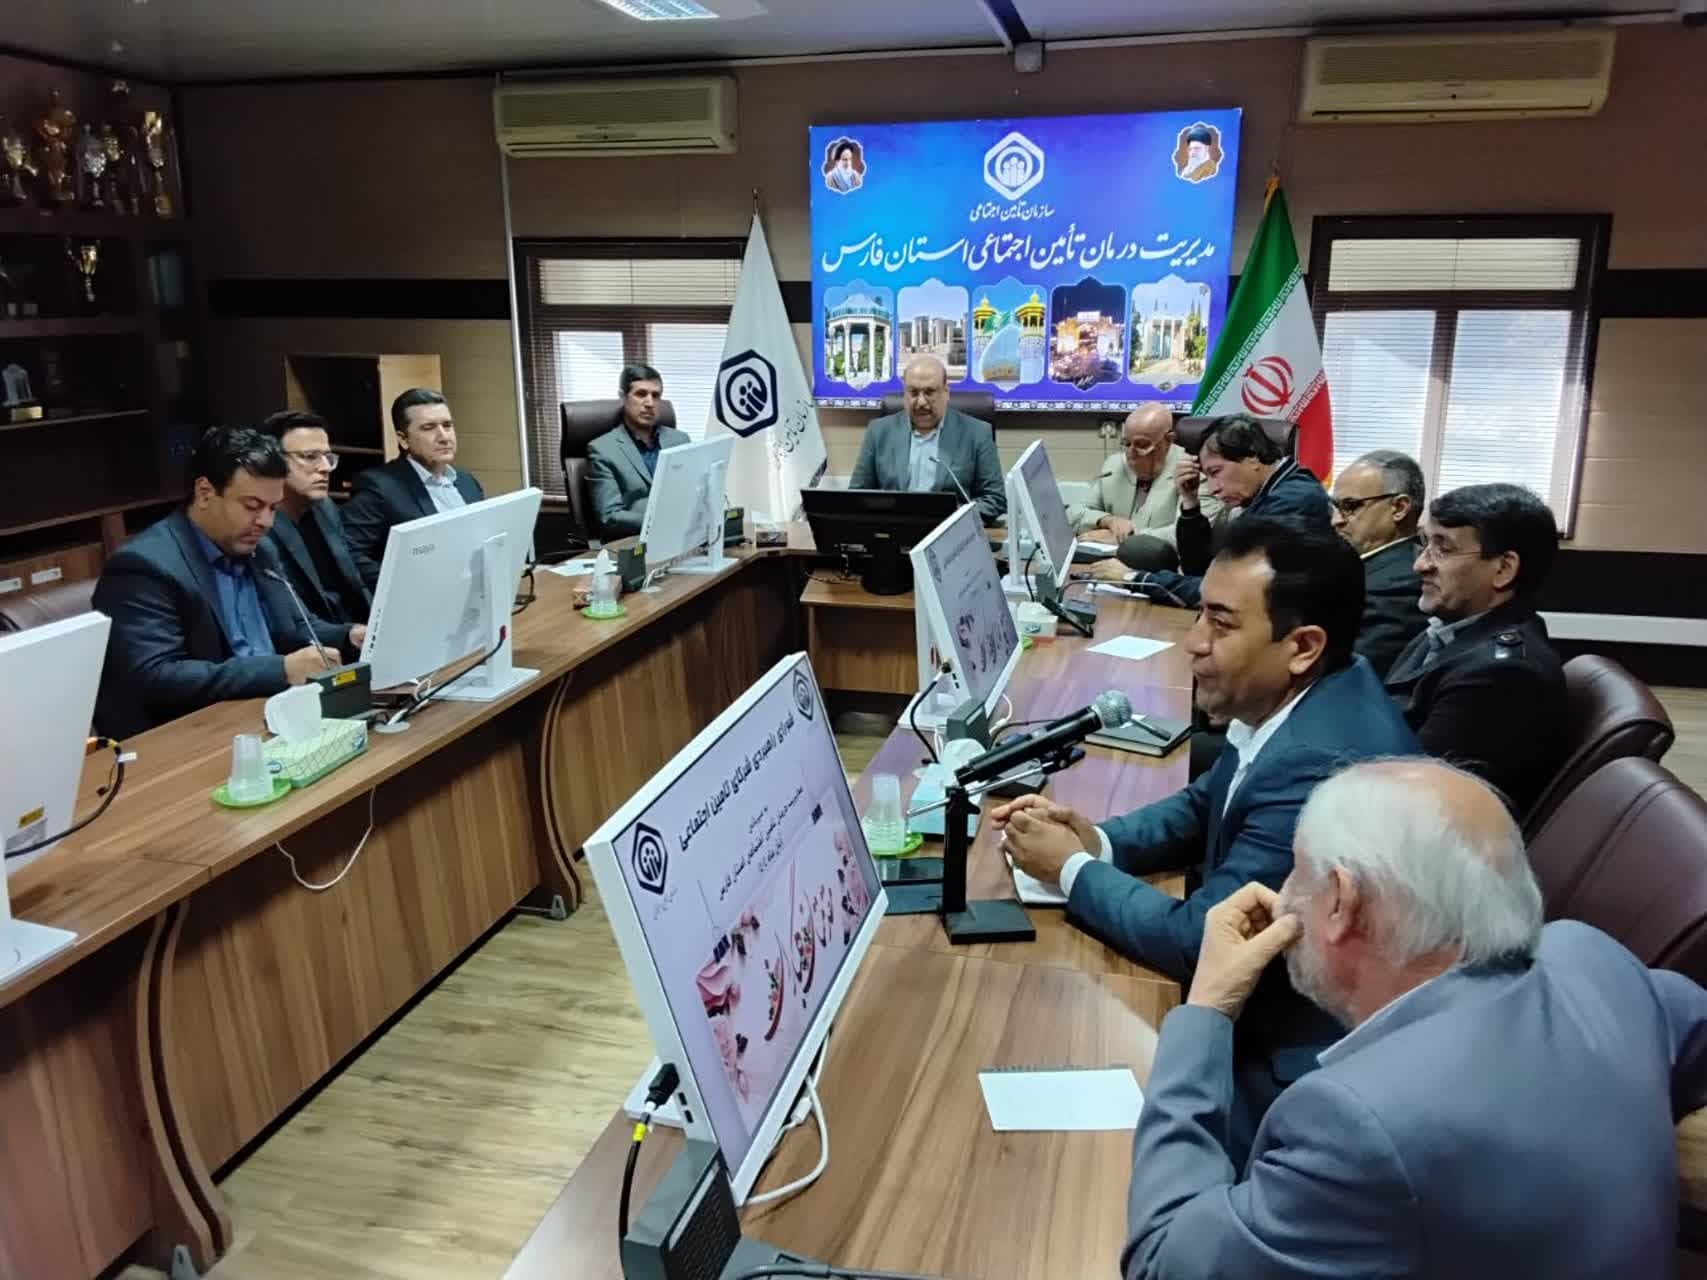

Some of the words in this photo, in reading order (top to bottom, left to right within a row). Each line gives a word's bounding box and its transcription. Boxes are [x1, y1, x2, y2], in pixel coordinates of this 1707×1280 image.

[969, 201, 1000, 222] اجتماعی
[1021, 203, 1056, 221] سازمان
[821, 231, 884, 273] فارس
[883, 236, 969, 272] استان
[967, 232, 1032, 271] اجتماعی
[1029, 223, 1086, 270] تأمین
[1079, 231, 1138, 270] درمان
[1138, 232, 1216, 267] مدیریت
[678, 801, 711, 852] اجتماعی
